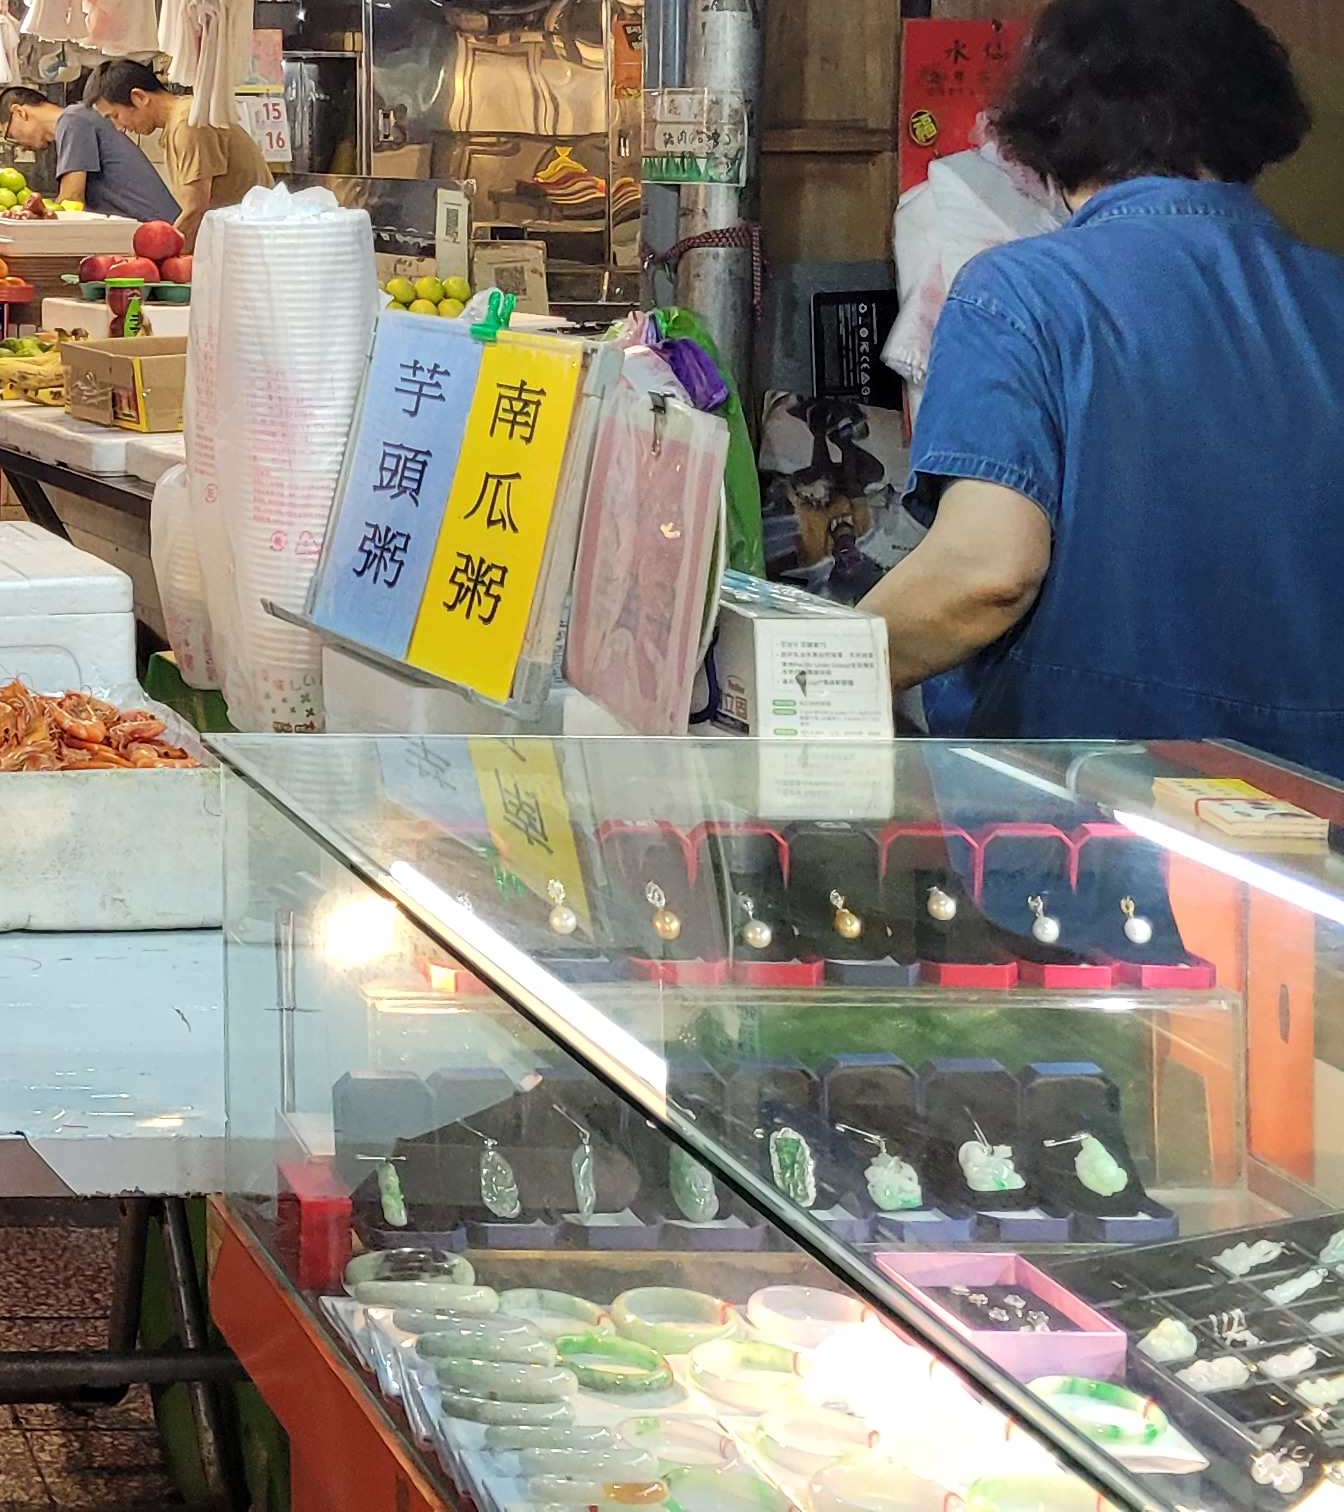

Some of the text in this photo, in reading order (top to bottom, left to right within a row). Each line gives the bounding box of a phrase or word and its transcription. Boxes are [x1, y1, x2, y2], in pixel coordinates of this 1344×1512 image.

[262, 102, 282, 121] 15
[265, 131, 286, 150] 16
[352, 360, 451, 589] 芋頭粥
[442, 378, 547, 627] 南瓜粥
